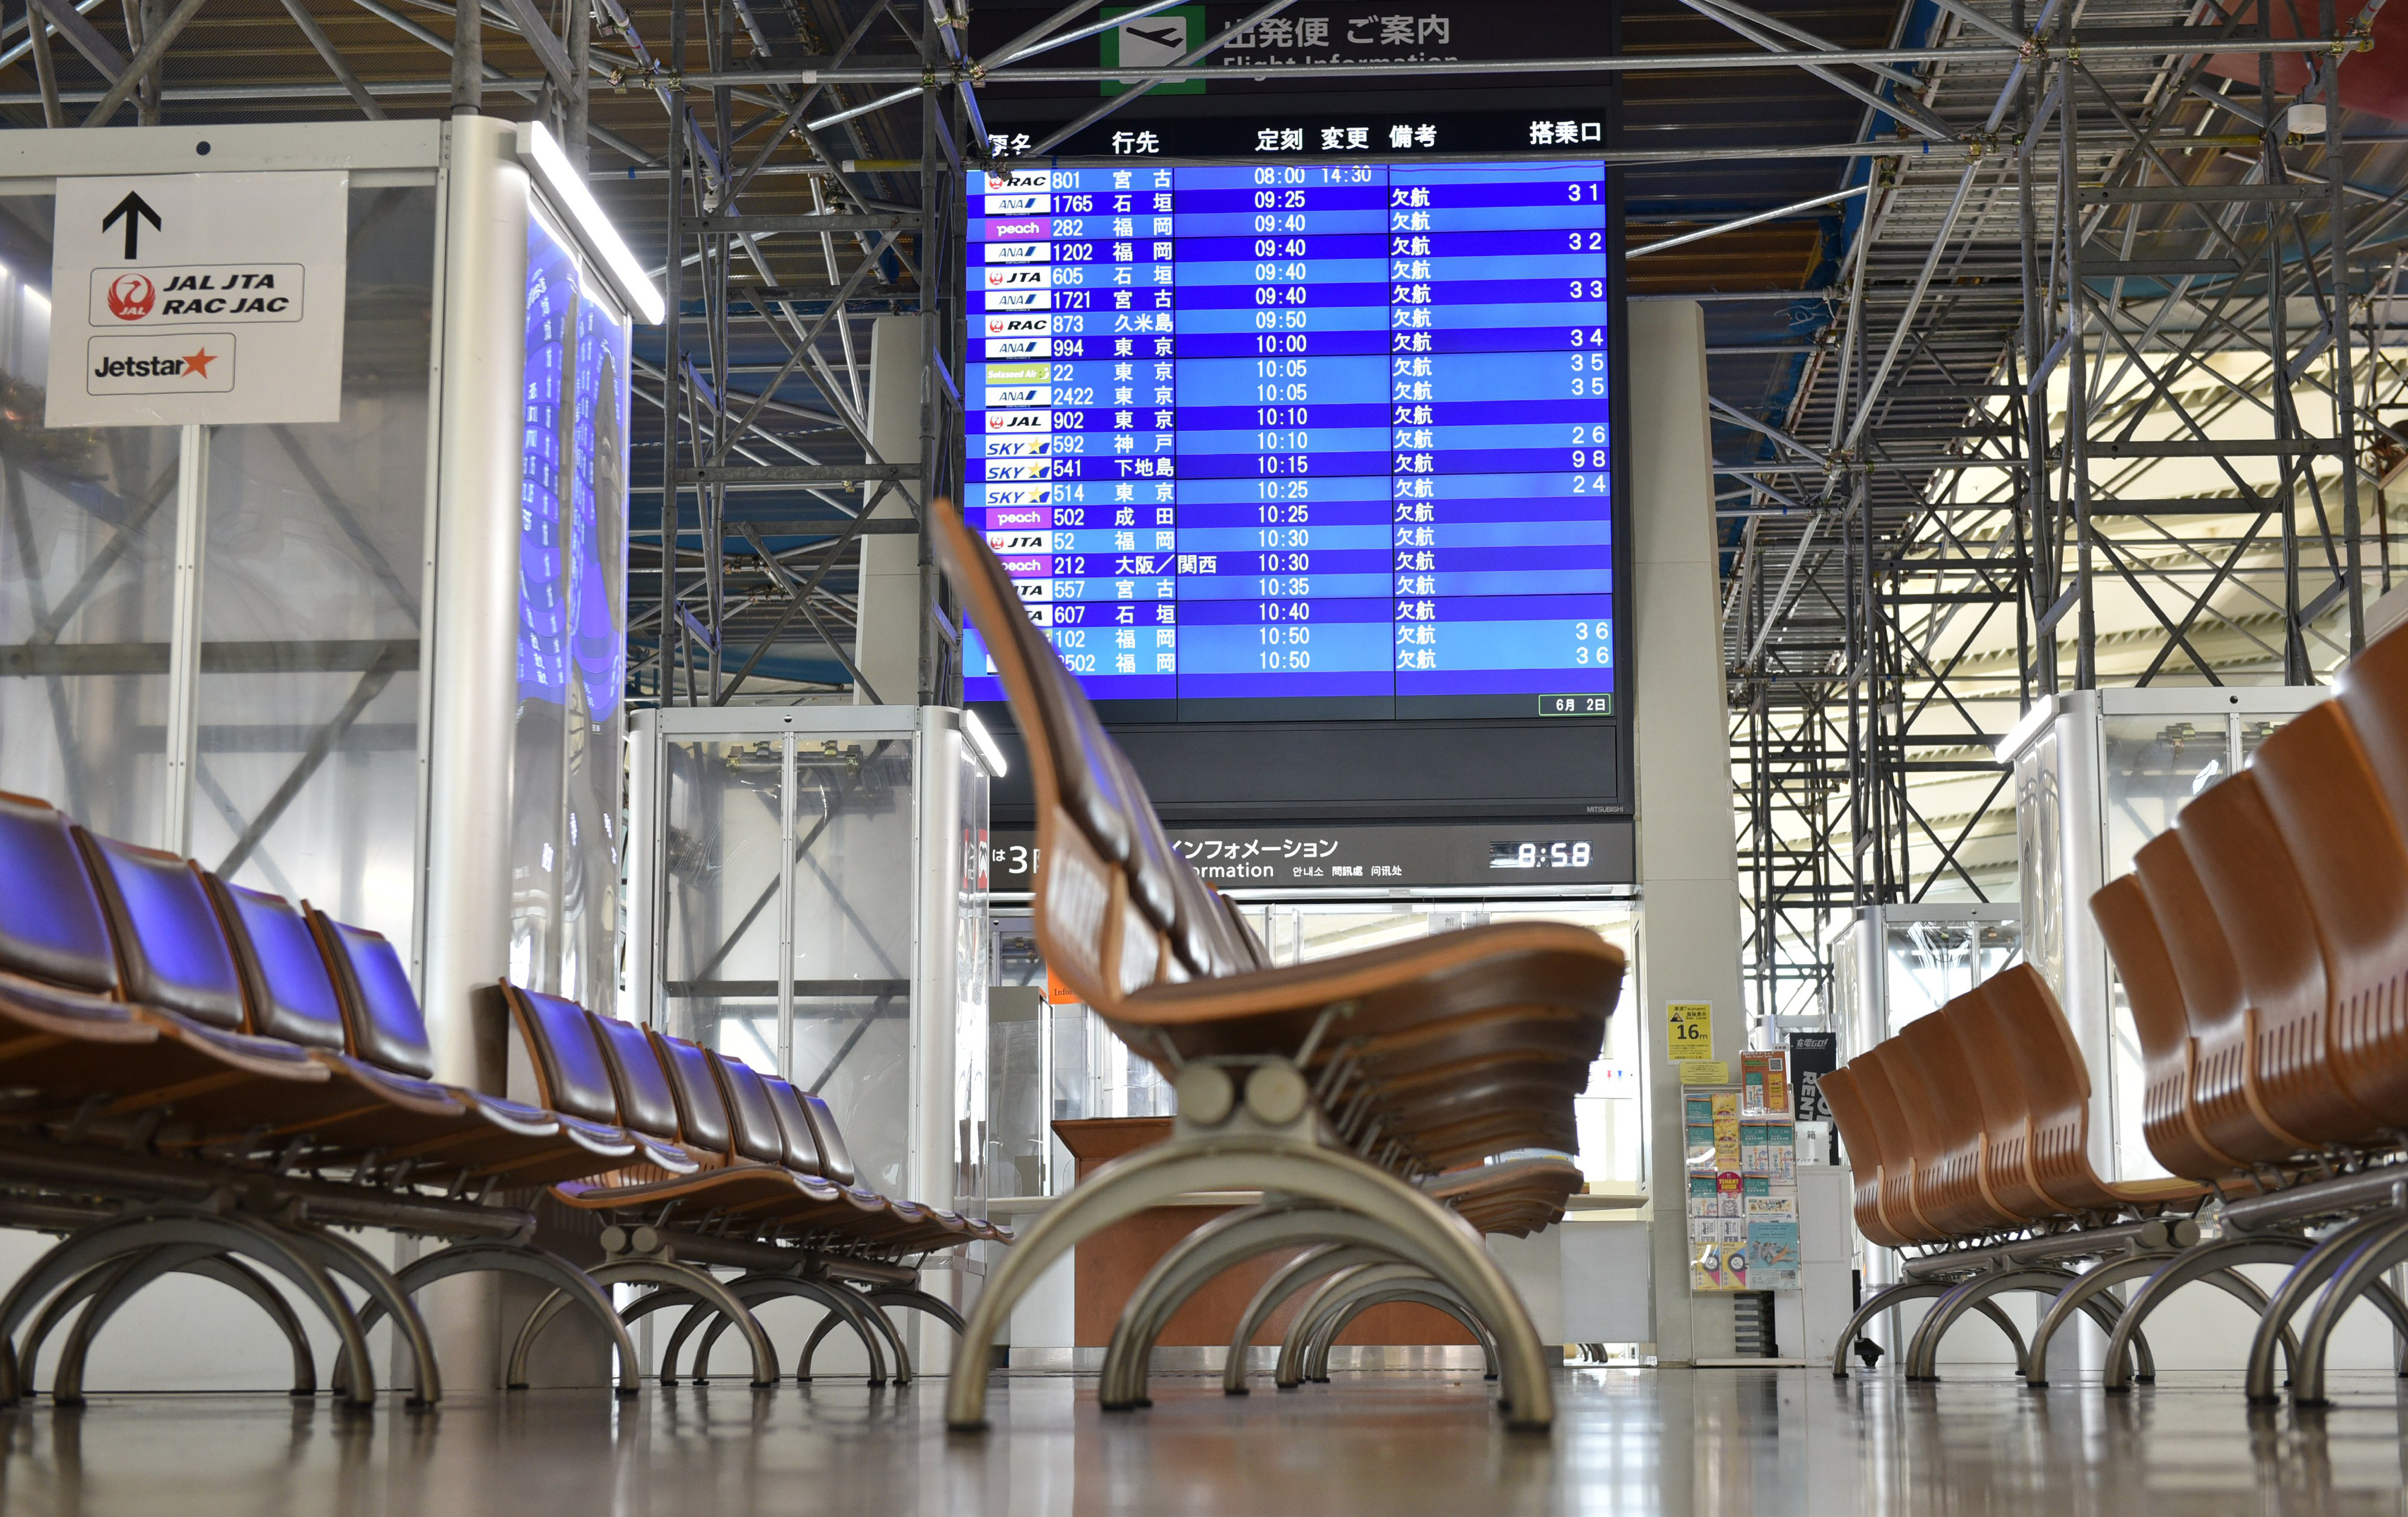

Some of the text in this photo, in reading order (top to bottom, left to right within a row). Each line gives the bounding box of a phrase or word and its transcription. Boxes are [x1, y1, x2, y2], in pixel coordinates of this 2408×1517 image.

[1224, 14, 1450, 49] 出発便 ご案内
[1112, 131, 1159, 154] 行先
[1255, 128, 1303, 152] 定刻
[1321, 127, 1369, 150] 変更
[1389, 124, 1437, 148] 備考
[1530, 121, 1602, 145] 搭乗口
[1053, 171, 1079, 189] 801
[1113, 169, 1172, 189] 宮古
[1255, 166, 1305, 185] 08:00
[1322, 165, 1372, 183] 14:30
[999, 199, 1023, 209] ANA
[1054, 195, 1093, 212] 1765
[1112, 193, 1172, 212] 石垣
[1255, 190, 1305, 208] 09:25
[1390, 187, 1430, 207] 欠航
[996, 211, 1430, 237] peach 282 福岡 09:40 欠航
[999, 248, 1023, 257] ANA
[1054, 243, 1092, 261] 1202
[1112, 242, 1172, 262] 福岡
[1255, 239, 1306, 257] 09:40
[1391, 236, 1431, 256] 欠航
[163, 274, 275, 291] JAL JTA
[1007, 260, 1431, 285] JTA 605 石垣 09:40 欠航
[162, 297, 289, 315] RAC JAC
[999, 295, 1024, 305] ANA
[1054, 290, 1090, 309] 1721
[1113, 289, 1172, 309] 宮古
[1256, 287, 1306, 304] 09:40
[1391, 284, 1431, 304] 欠航
[119, 307, 146, 315] JAL
[1007, 307, 1432, 333] RAC 873 久米島 09:50 欠航
[999, 343, 1024, 353] ANA
[1054, 339, 1084, 356] 994
[1113, 336, 1174, 357] 東京
[1257, 334, 1307, 353] 10:00
[1392, 331, 1432, 352] 欠航
[95, 357, 185, 377] Jetstar
[1025, 369, 1037, 378] Air
[1053, 364, 1073, 381] 22
[1113, 361, 1174, 382] 東京
[1257, 359, 1307, 378] 10:05
[1392, 356, 1432, 377] 欠航
[999, 392, 1024, 401] ANA
[1053, 387, 1093, 405] 2422
[1114, 385, 1174, 406] 東京
[1257, 383, 1307, 402] 10:05
[1393, 381, 1433, 401] 欠航
[1007, 405, 1433, 430] JAL 902 東京 10:10 欠航
[987, 443, 1024, 455] SKY
[1053, 435, 1084, 453] 592
[1114, 434, 1174, 454] 神戸
[1258, 431, 1308, 449] 10:10
[1393, 428, 1433, 449] 欠航
[987, 467, 1024, 479] SKY
[1054, 459, 1080, 477] 541
[1114, 457, 1174, 477] 下地島
[1258, 455, 1308, 474] 10:15
[1394, 453, 1434, 473] 欠航
[987, 492, 1024, 503] SKY
[1054, 484, 1085, 502] 514
[1114, 482, 1174, 502] 東京
[1258, 480, 1308, 499] 10:25
[1394, 477, 1434, 498] 欠航
[998, 502, 1434, 526] peach 502 成田 10:25 欠航
[1008, 526, 1435, 551] JTA 52 福岡 10:30 欠航
[1055, 556, 1085, 574] 212
[1259, 553, 1309, 571] 10:30
[1395, 550, 1435, 571] 欠航
[1054, 574, 1436, 599] 557 宮古 10:35 欠航
[1055, 606, 1085, 623] 607
[1115, 604, 1175, 624] 石垣
[1259, 603, 1309, 620] 10:40
[1396, 600, 1436, 620] 欠航
[1056, 630, 1086, 648] 102
[1115, 628, 1175, 649] 福岡
[1260, 627, 1309, 645] 10:50
[1396, 624, 1436, 645] 欠航
[1115, 653, 1175, 673] 福岡
[1260, 650, 1310, 669] 10:50
[1396, 648, 1437, 669] 欠航
[1556, 698, 1606, 712] 6月 2日
[1518, 843, 1590, 867] 8:58
[1293, 867, 1324, 877] 안내소
[1332, 866, 1363, 877] 問訊處
[1371, 865, 1402, 877] 问讯处
